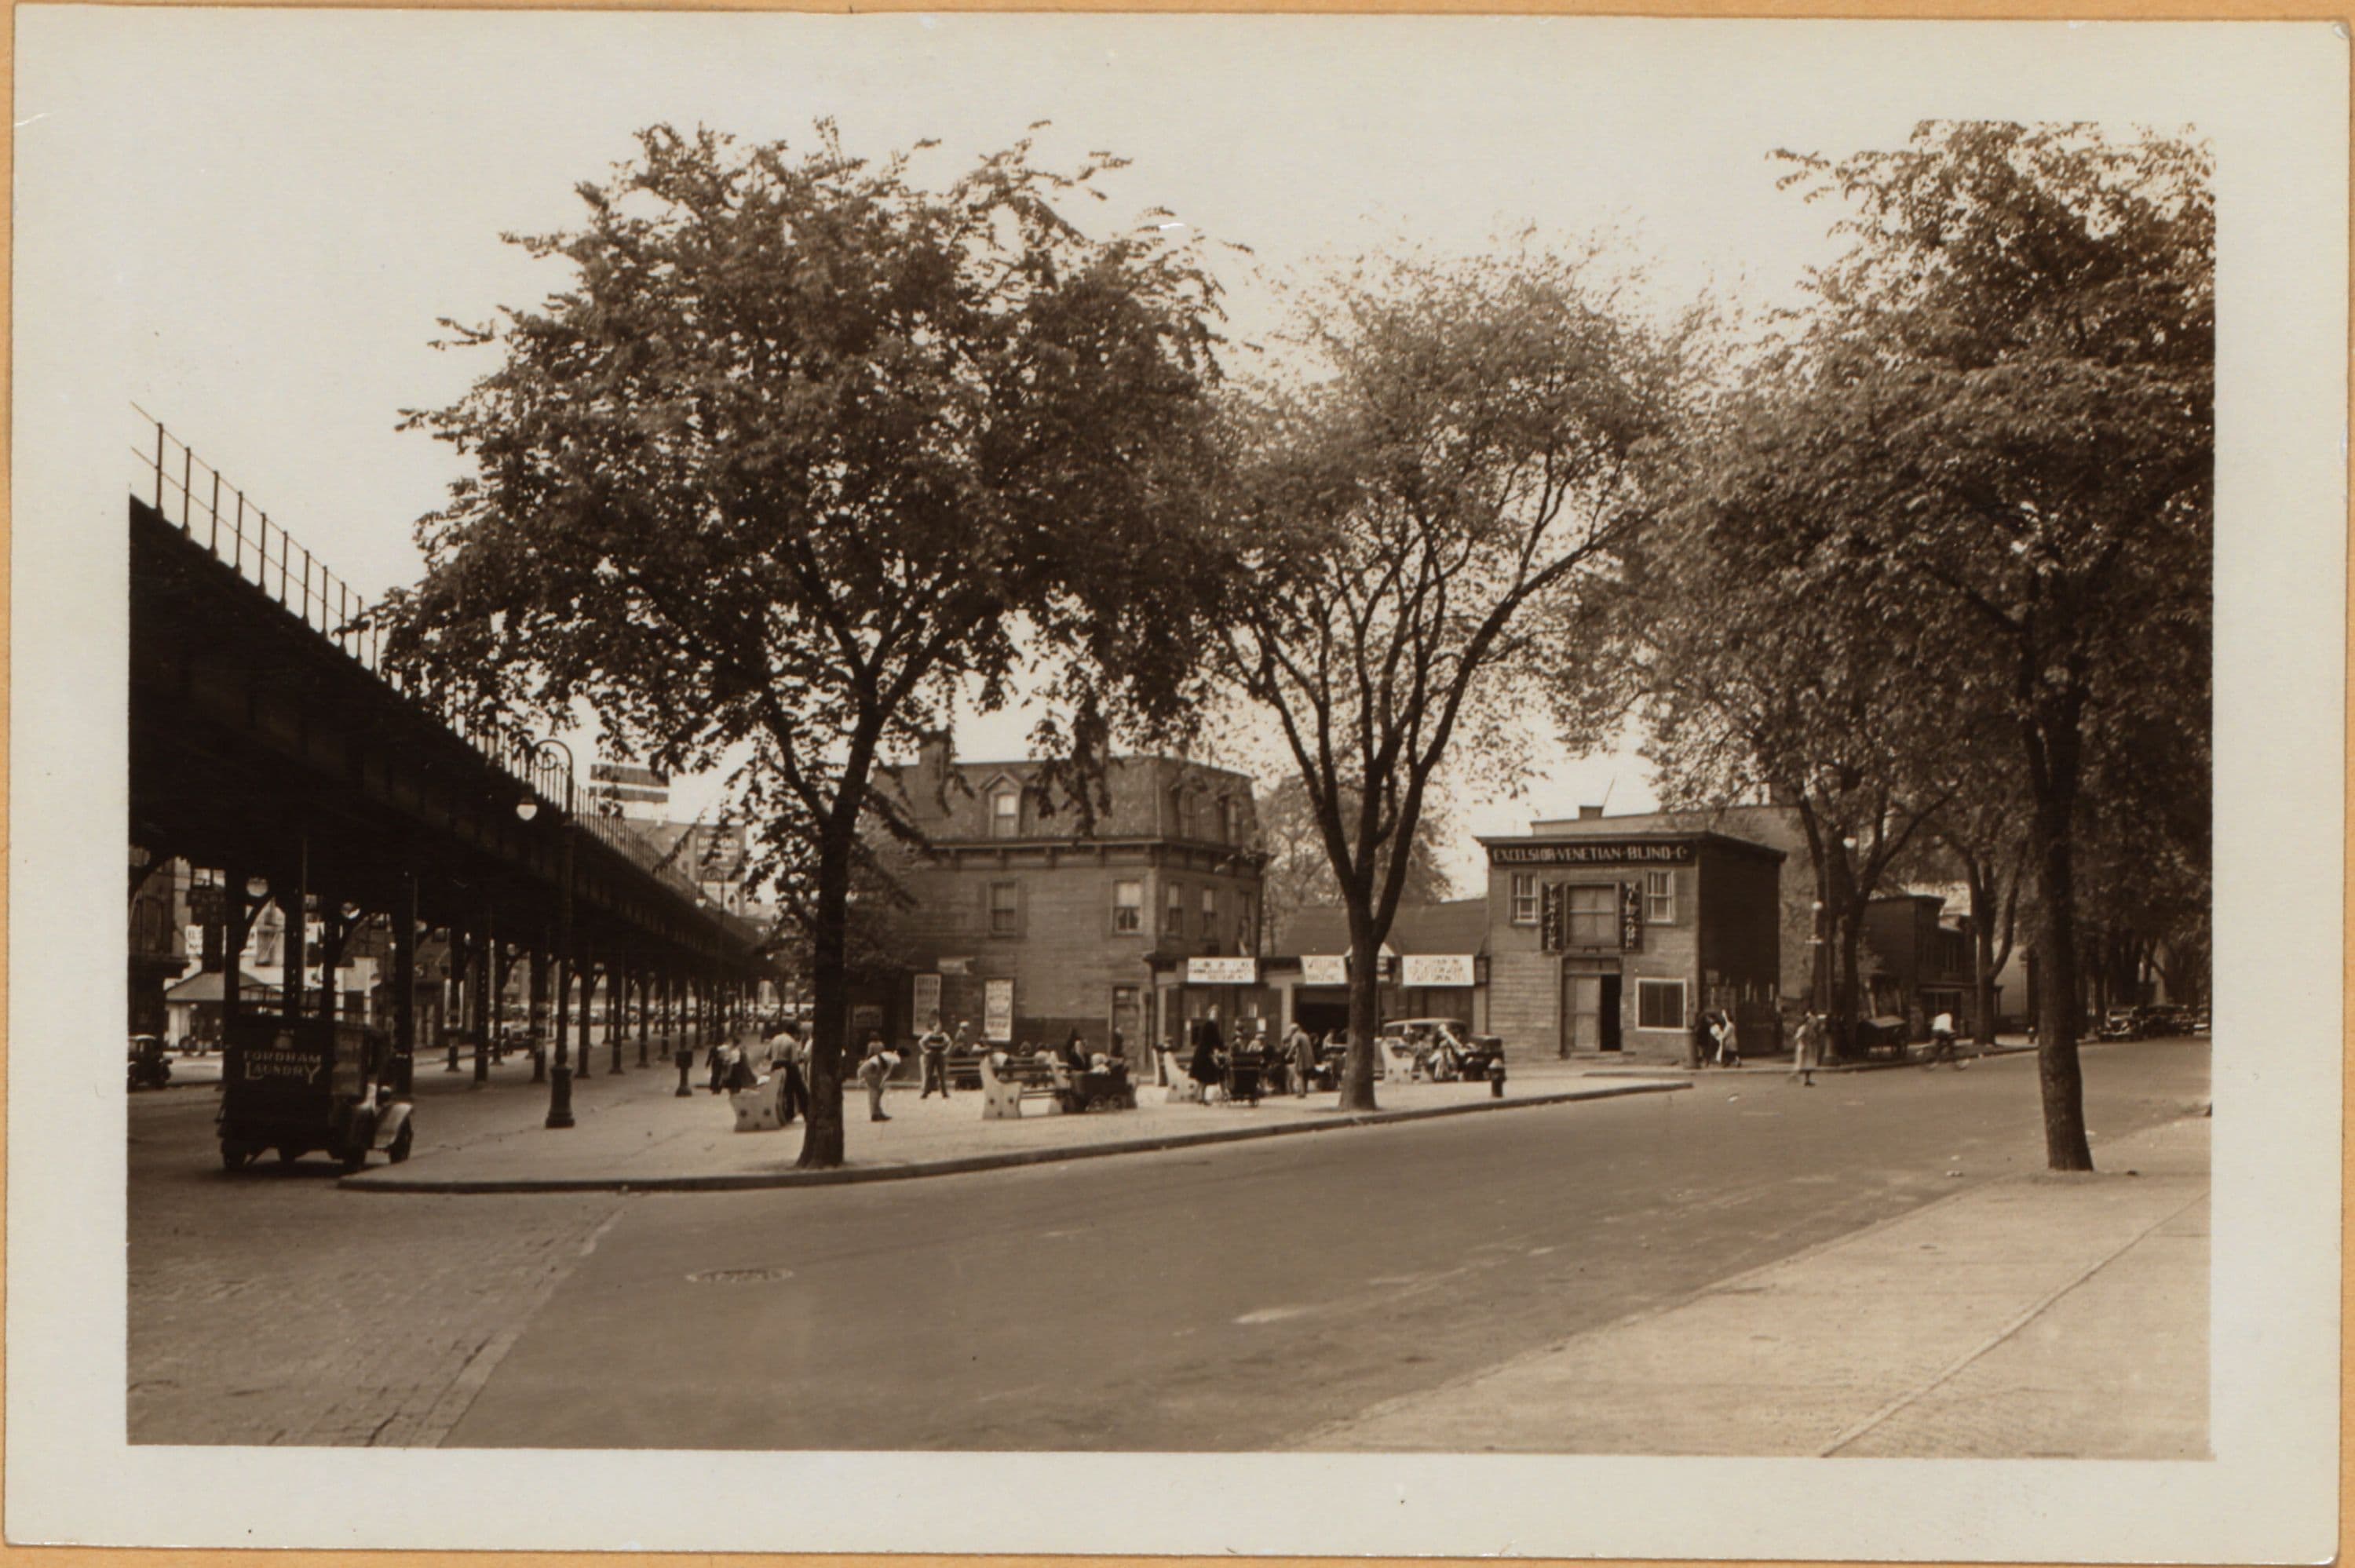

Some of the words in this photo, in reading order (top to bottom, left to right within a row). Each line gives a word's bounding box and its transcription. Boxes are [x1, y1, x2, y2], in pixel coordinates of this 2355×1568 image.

[1556, 846, 1622, 860] VENETIAN
[1627, 845, 1670, 859] BLIND
[243, 1050, 321, 1063] FORDHAM
[244, 1060, 322, 1085] LAUNDRY
